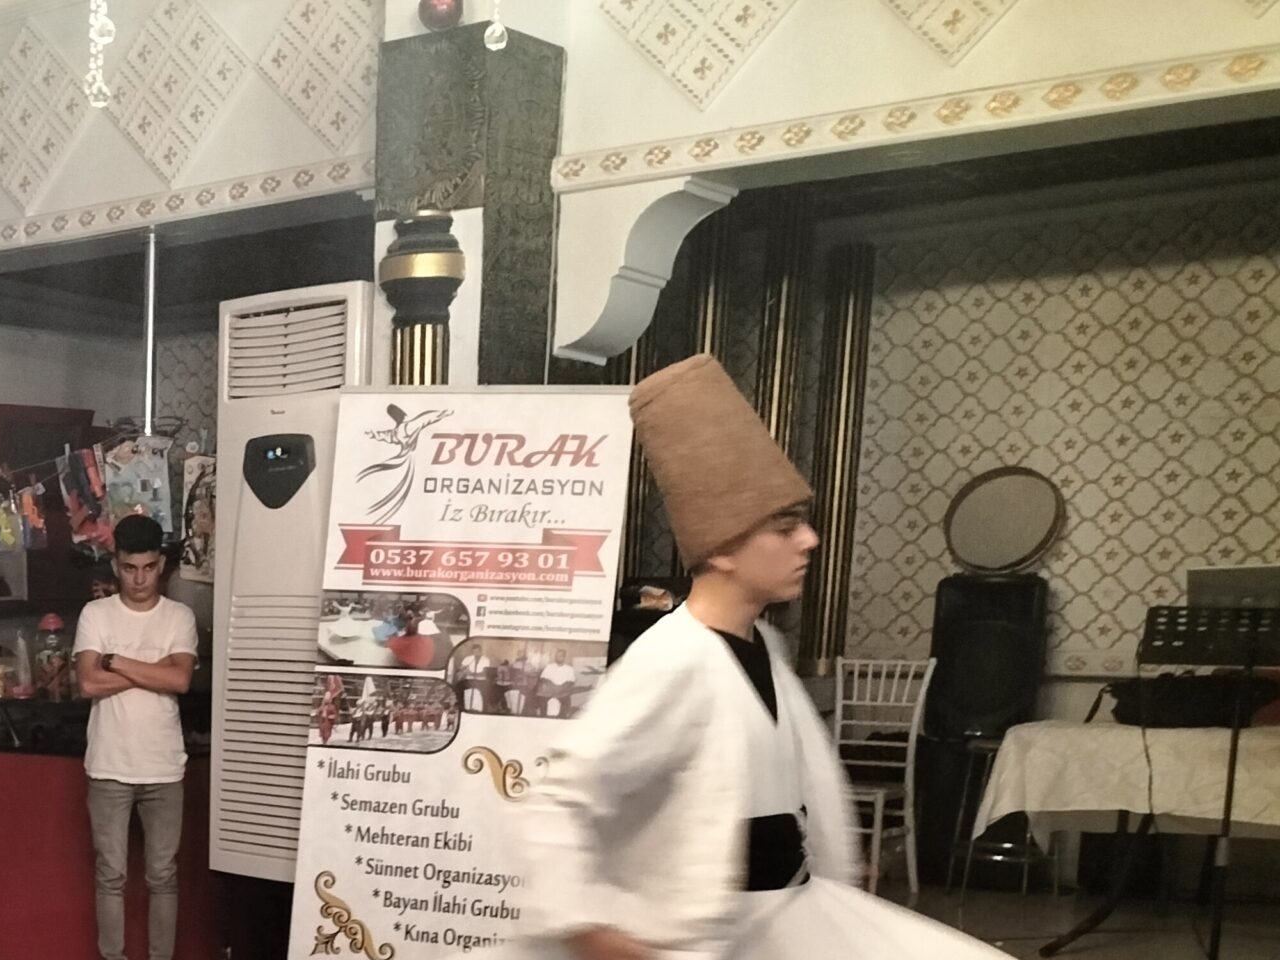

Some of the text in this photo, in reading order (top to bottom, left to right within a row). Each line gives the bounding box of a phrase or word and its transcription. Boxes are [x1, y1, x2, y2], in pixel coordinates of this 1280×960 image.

[430, 432, 609, 468] BURAK
[424, 473, 604, 496] ORGANİZASYON
[439, 499, 463, 522] İz
[370, 549, 570, 570] 0537 657 93 01
[370, 567, 569, 583] www.burakorganizasyon.com
[327, 757, 411, 784] İlahi Grubu
[340, 793, 460, 819] Semazen Grubu
[354, 826, 473, 853] Mehteran Ekibi
[365, 858, 420, 880] Sünnet
[383, 891, 521, 920] Bayan İlahi Grubu
[404, 924, 516, 953] Kına Organi
